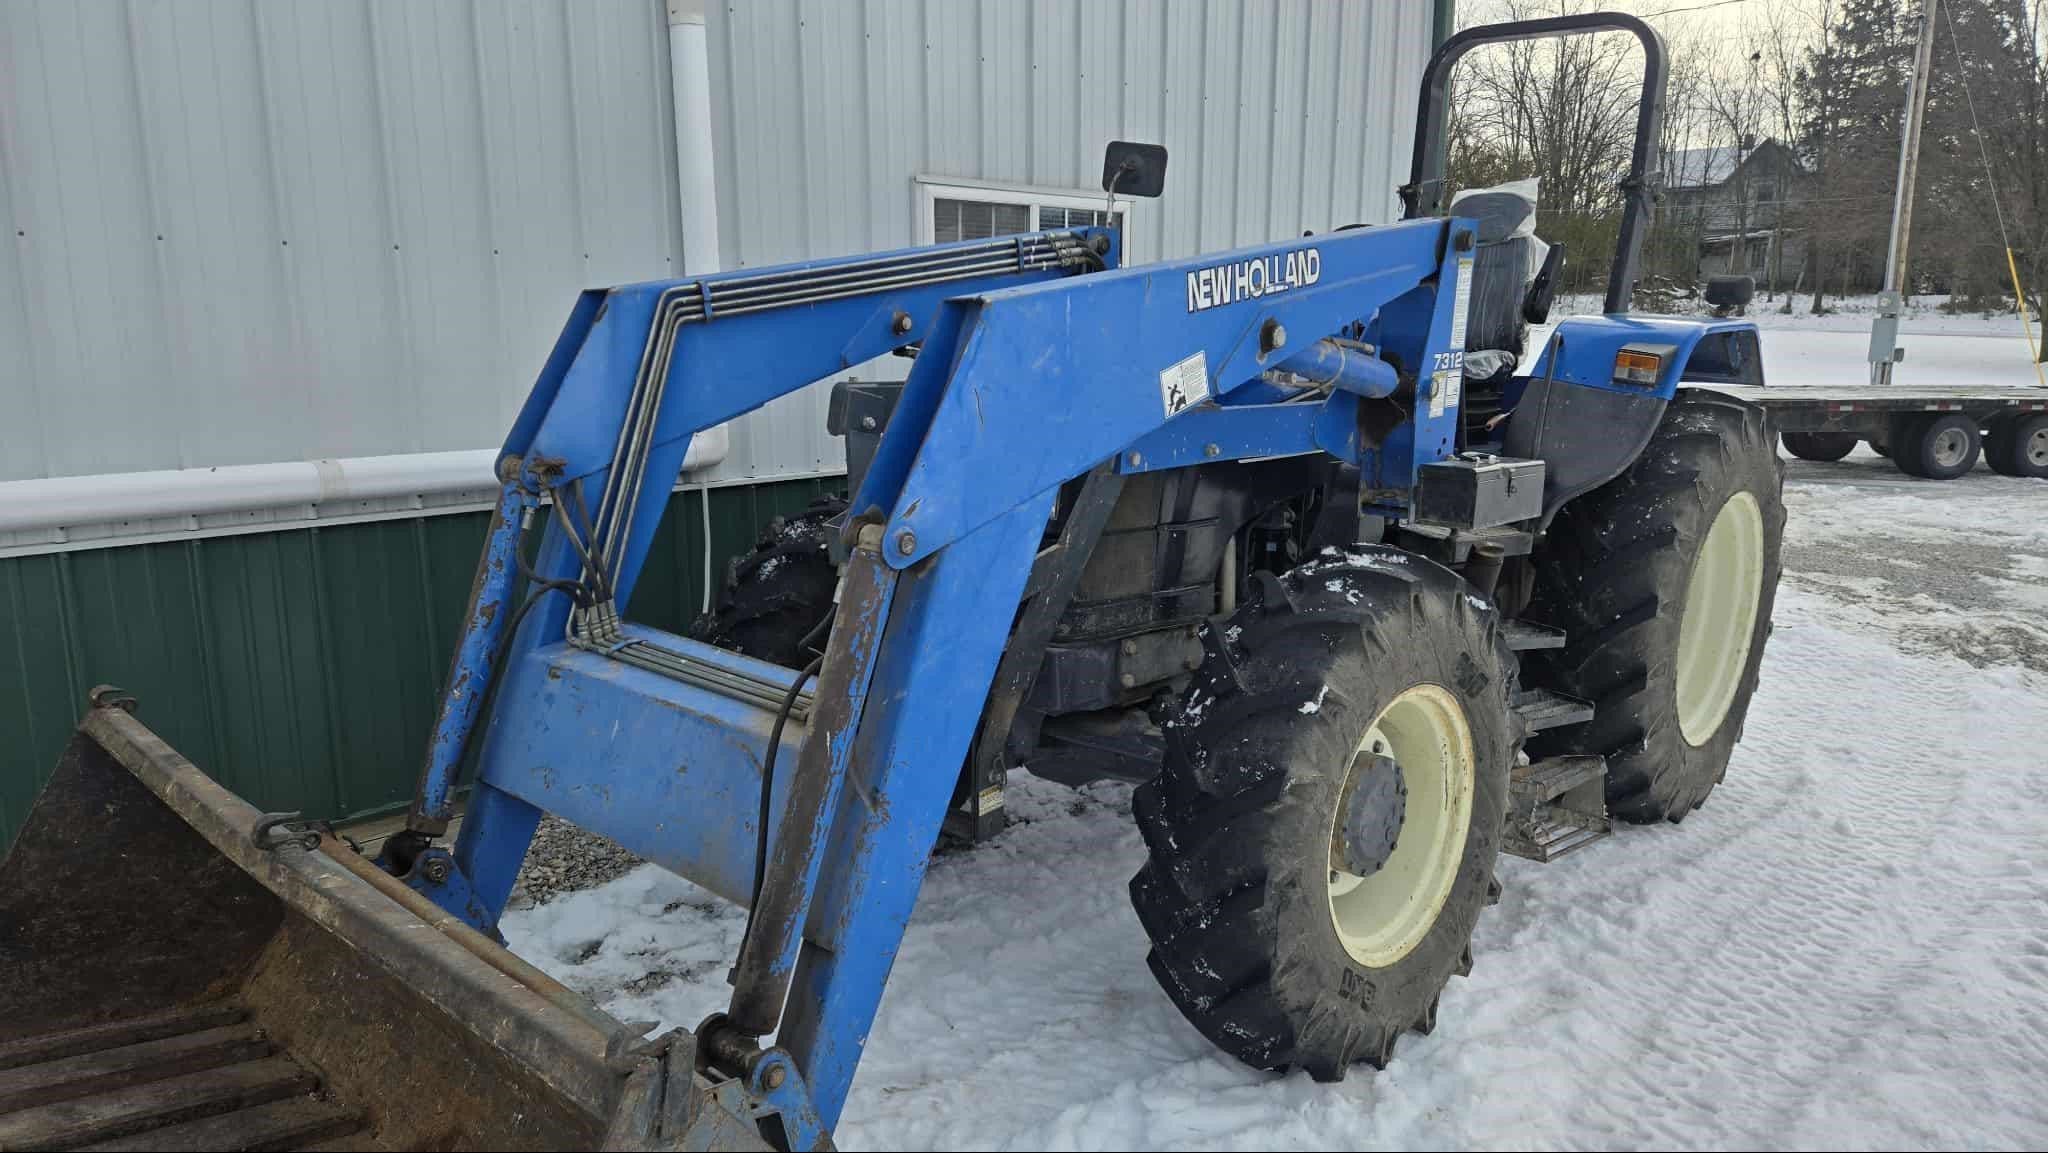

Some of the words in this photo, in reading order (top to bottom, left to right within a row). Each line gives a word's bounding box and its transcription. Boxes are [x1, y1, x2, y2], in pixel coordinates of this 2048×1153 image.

[1187, 263, 1232, 313] NEW
[1234, 248, 1321, 303] HOLLAND
[1433, 351, 1463, 371] 7312
